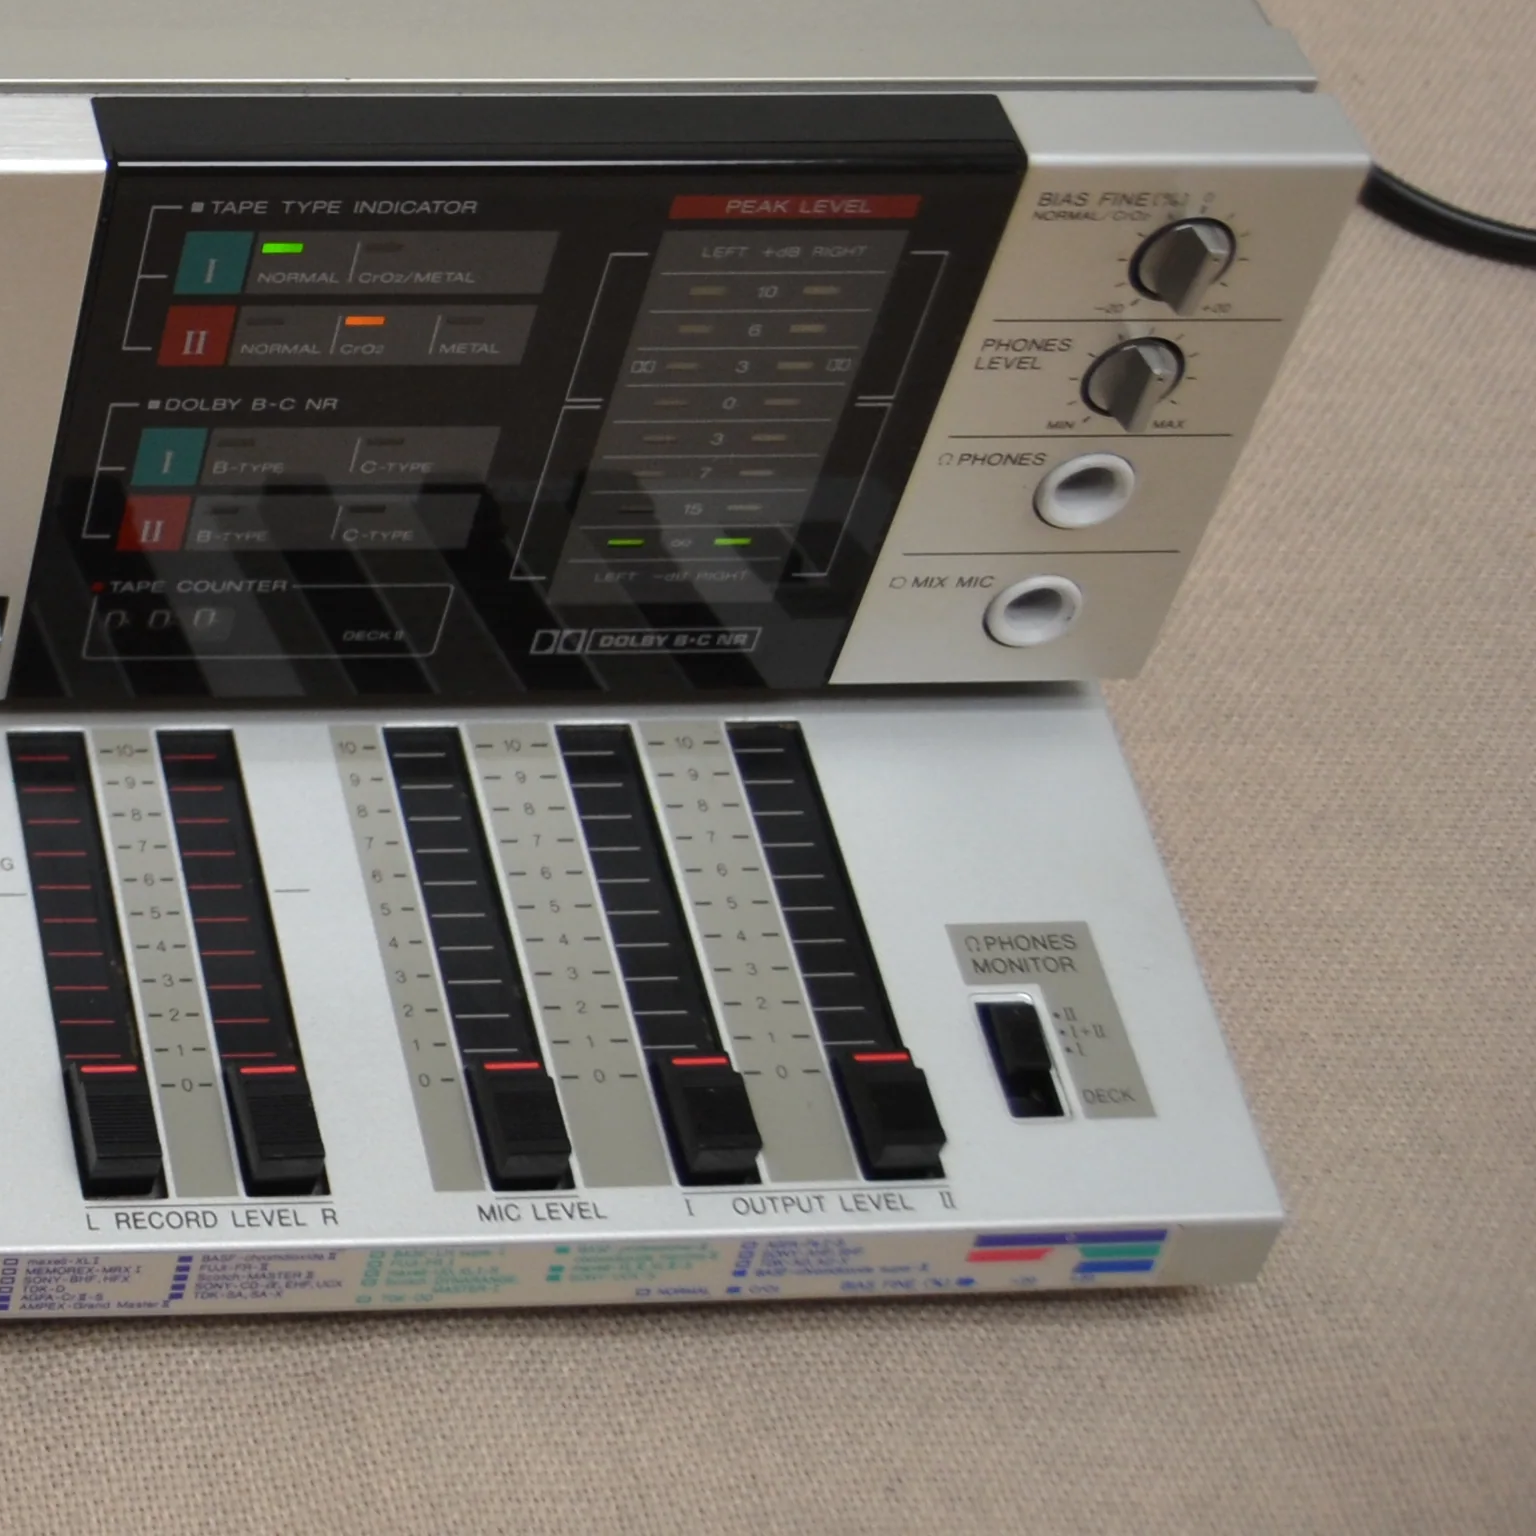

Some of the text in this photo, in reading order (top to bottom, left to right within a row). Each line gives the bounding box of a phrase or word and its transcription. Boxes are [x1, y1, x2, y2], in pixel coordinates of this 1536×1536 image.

[726, 199, 872, 214] PEAK LEVEL
[1037, 192, 1150, 207] BIAS FINE
[211, 200, 479, 215] TAPE TYPE INDICATOR
[702, 246, 868, 259] LEFT RIGHT
[257, 271, 339, 284] NORMAL
[240, 343, 321, 355] NORMAL
[439, 342, 500, 355] METAL
[981, 338, 1073, 352] PHONES
[974, 356, 1042, 371] LEVEL
[164, 398, 242, 411] DOLBY
[305, 398, 340, 411] NR
[1047, 419, 1076, 430] MIN
[1153, 419, 1186, 430] MAX
[957, 452, 1048, 467] PHONES
[212, 461, 285, 475] B-TYPE
[361, 461, 434, 474] C-TYPE
[342, 528, 414, 542] C-TYPE
[109, 579, 288, 593] TAPE COUNTER
[910, 575, 996, 589] MIX MIC
[598, 633, 669, 648] DOLBY
[137, 841, 148, 854] 7
[143, 874, 155, 887] 6
[150, 907, 162, 920] 5
[156, 940, 168, 953] 4
[985, 933, 1078, 952] PHONES
[971, 956, 1078, 975] MONITOR
[162, 974, 175, 988] 3
[169, 1009, 181, 1023] 2
[177, 1044, 185, 1057] 1
[181, 1078, 194, 1093] 0
[1081, 1088, 1137, 1106] DECK
[732, 1190, 915, 1217] OUTPUT LEVEL
[478, 1199, 609, 1223] MIC LEVEL
[85, 1207, 340, 1232] L RECORD LEVEL R
